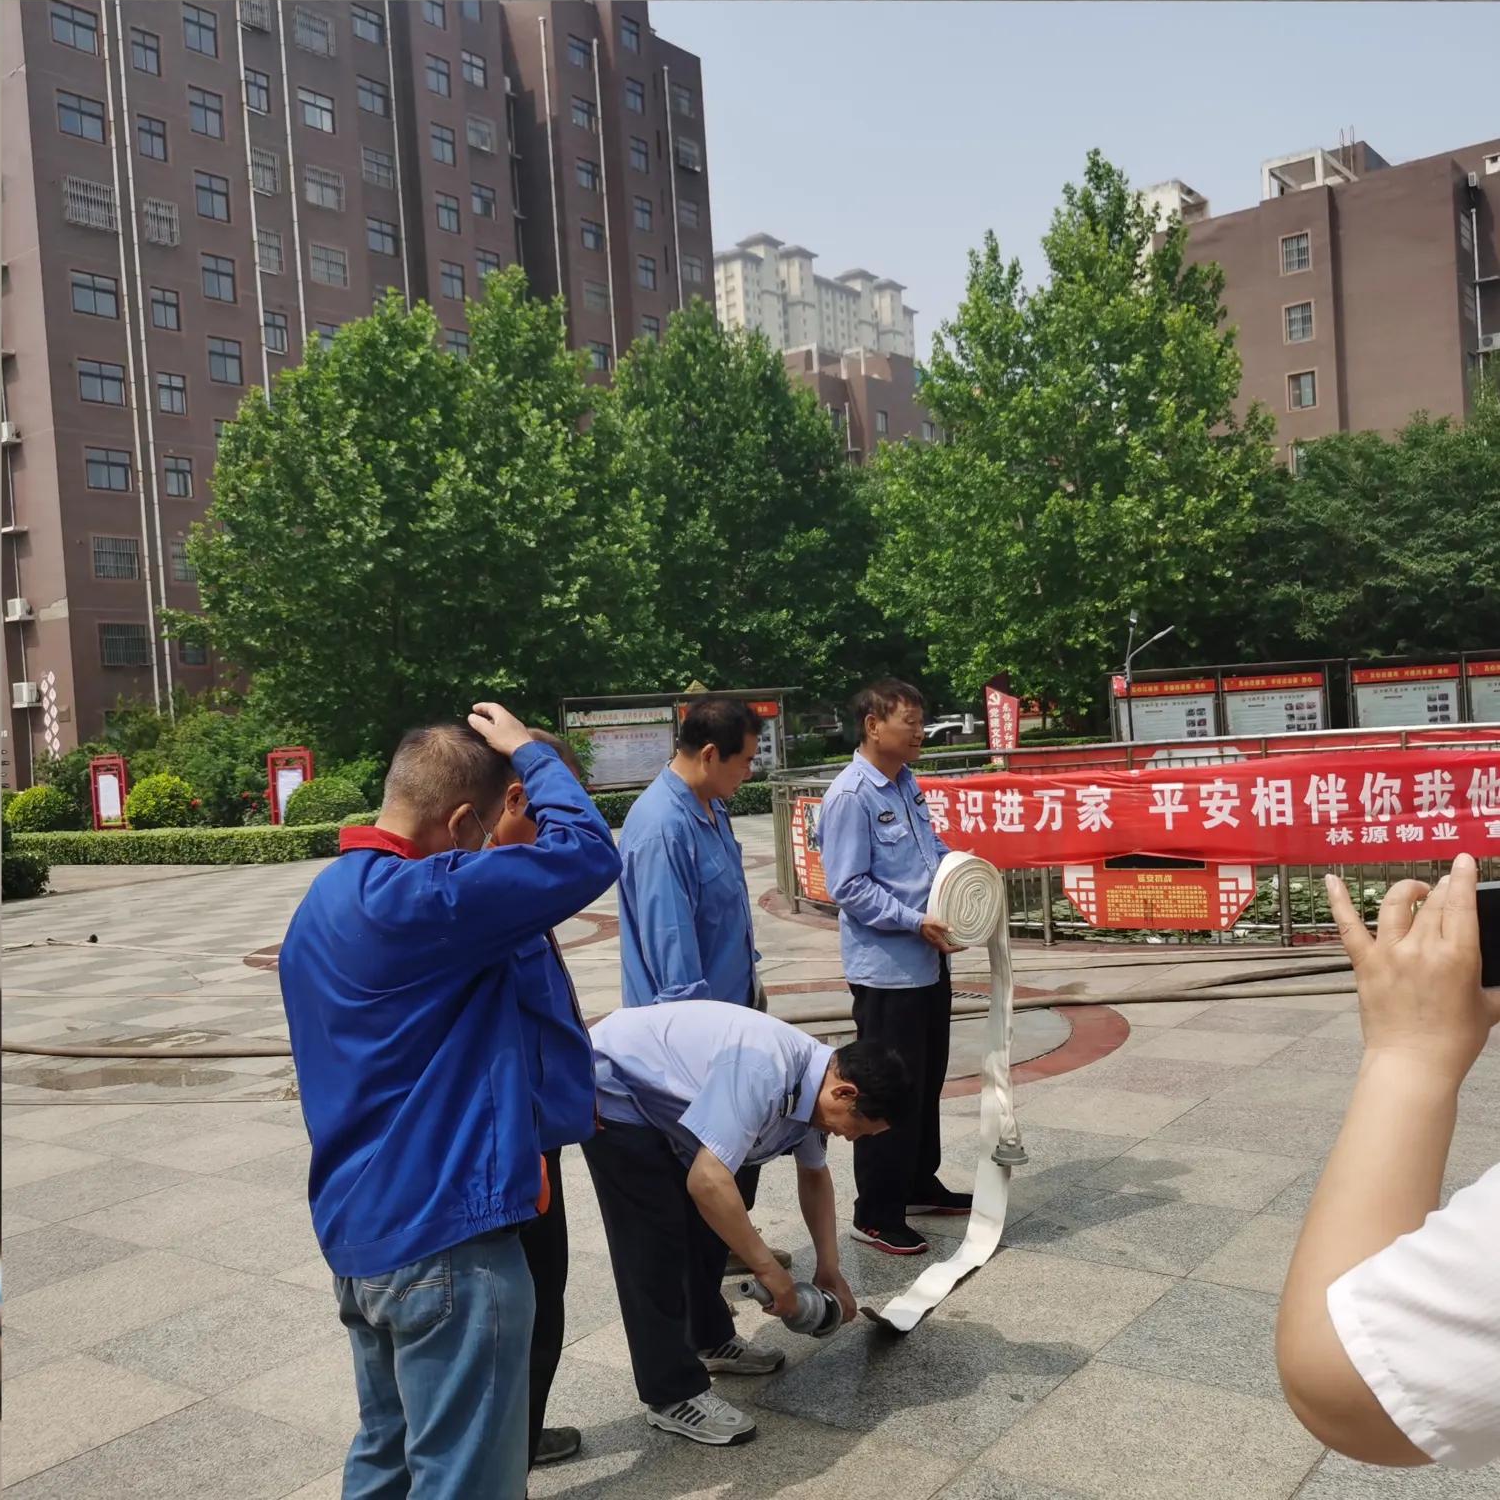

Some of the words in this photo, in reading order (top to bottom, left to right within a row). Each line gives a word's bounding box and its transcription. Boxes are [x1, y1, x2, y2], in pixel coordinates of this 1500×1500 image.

[924, 784, 1114, 833] 常识进万家
[1149, 767, 1500, 830] 平安相伴你我他
[1326, 822, 1460, 846] 林源物业
